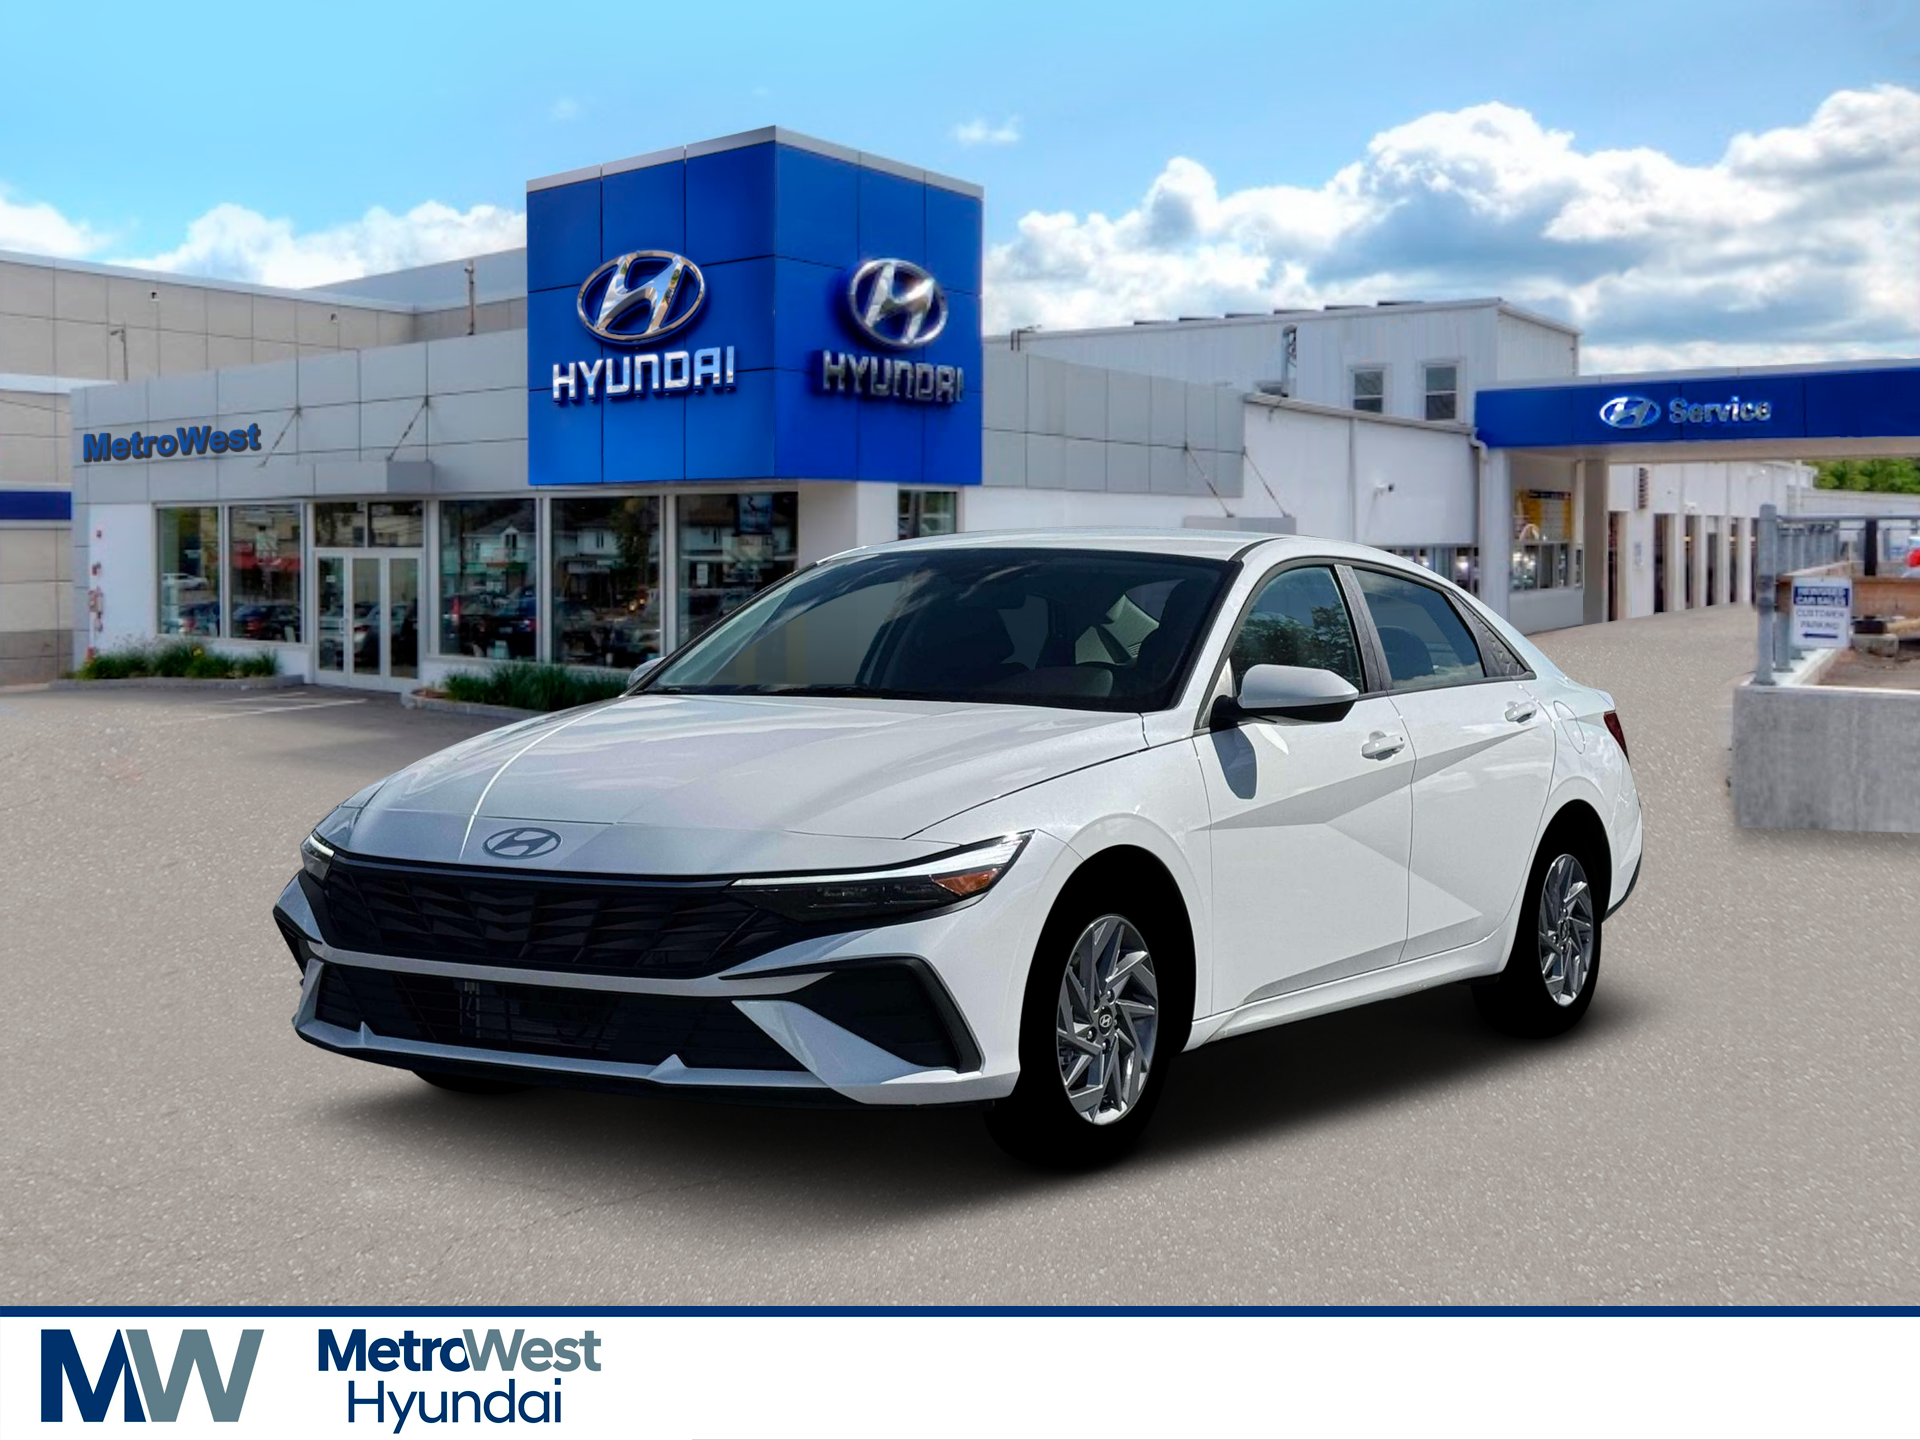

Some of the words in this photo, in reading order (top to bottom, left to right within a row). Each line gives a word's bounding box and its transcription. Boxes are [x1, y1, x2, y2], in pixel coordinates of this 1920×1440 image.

[552, 346, 735, 401] HYUNDAI
[822, 349, 965, 404] HYUNDAI
[1669, 395, 1771, 423] Service
[83, 423, 261, 462] MetroWest
[1797, 596, 1816, 606] CAR
[1817, 597, 1846, 607] SALES
[1797, 609, 1844, 618] CUSTOMER
[1800, 620, 1840, 630] PARKING
